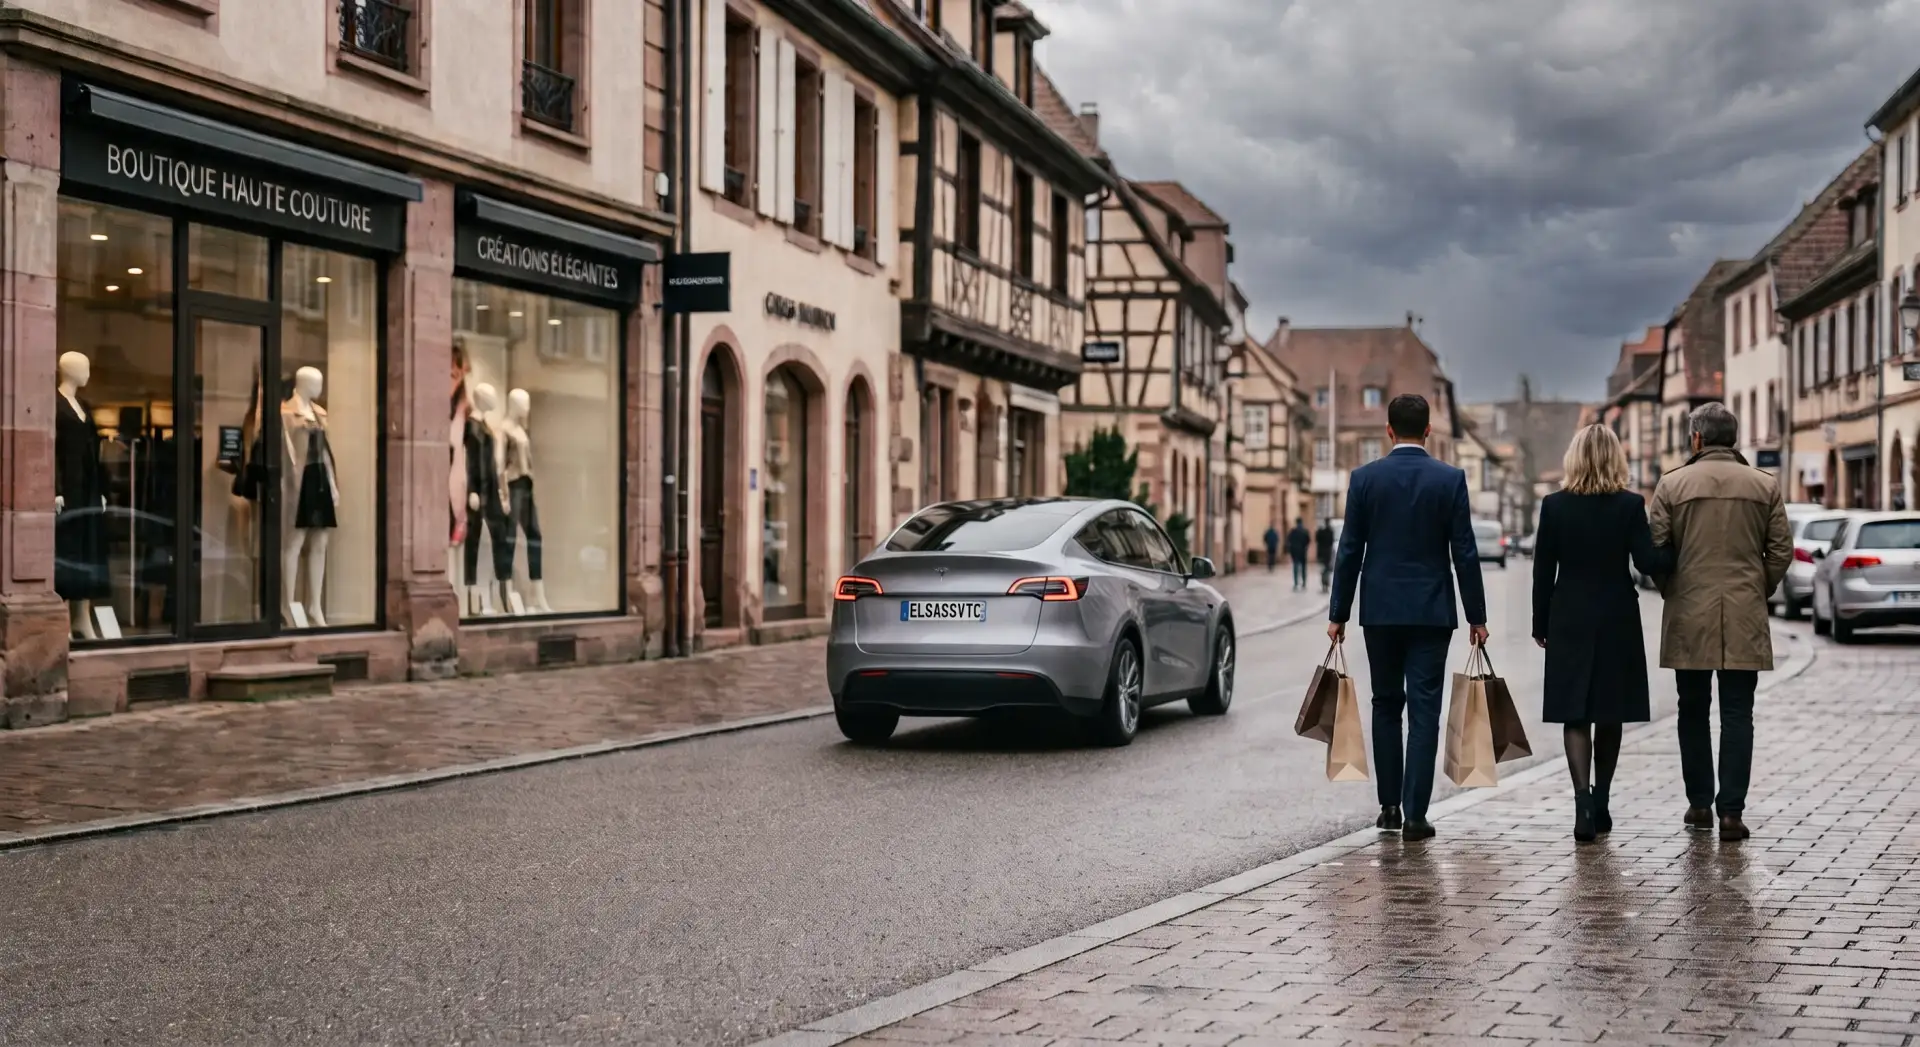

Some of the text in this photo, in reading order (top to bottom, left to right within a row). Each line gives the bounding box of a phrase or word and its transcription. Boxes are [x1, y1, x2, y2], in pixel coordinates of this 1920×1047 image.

[107, 143, 372, 233] BOUTIQUE HAUTE COUTURE
[477, 235, 618, 289] CRÉATIONS ÉLÉGANTES
[909, 602, 981, 618] ELSASSVTC
